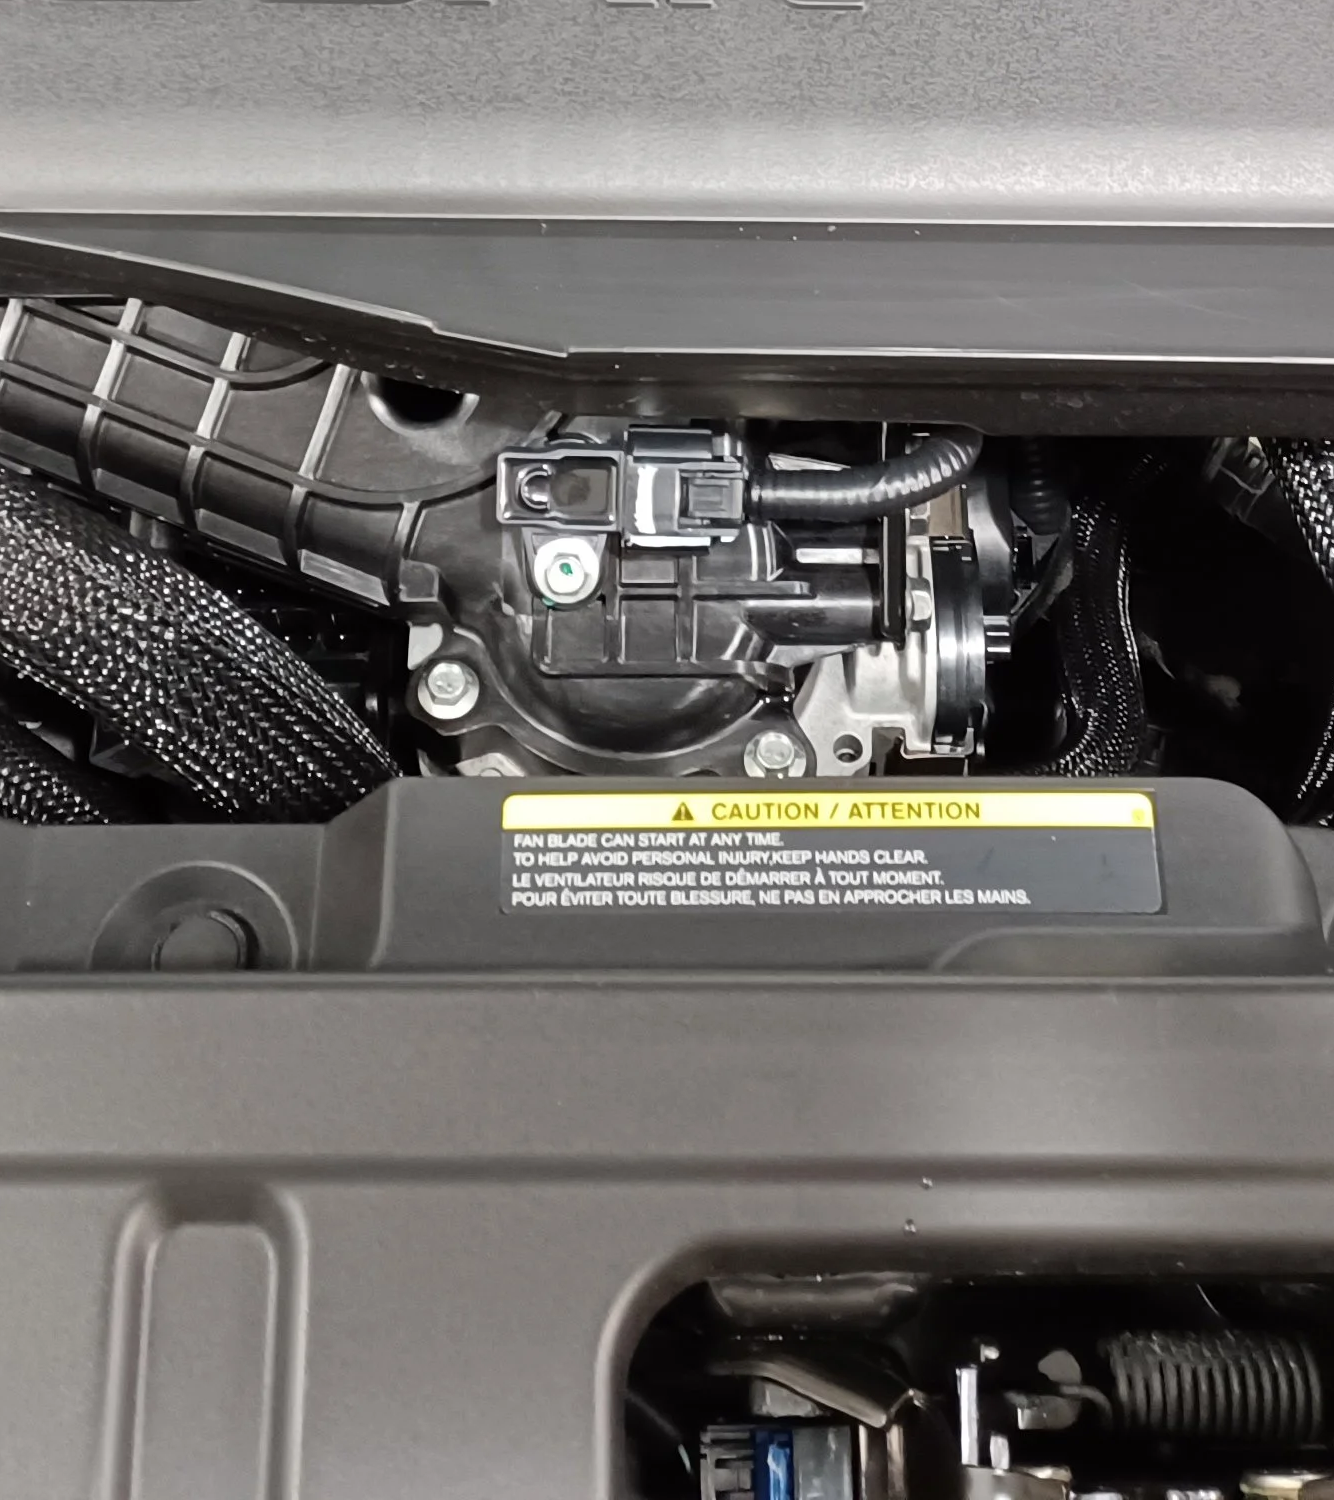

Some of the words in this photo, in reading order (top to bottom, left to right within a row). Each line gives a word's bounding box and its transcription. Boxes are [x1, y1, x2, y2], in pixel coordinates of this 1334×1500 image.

[711, 802, 819, 821] CAUTION
[829, 802, 839, 820] /
[848, 802, 981, 820] ATTENTION
[514, 833, 544, 848] FAN
[548, 833, 597, 848] BLADE
[601, 832, 635, 847] CAN
[637, 832, 685, 847] START
[688, 832, 707, 847] AT
[711, 832, 742, 847] ANY
[746, 832, 784, 846] TIME.
[513, 852, 533, 867] TO
[538, 851, 578, 866] HELP
[581, 851, 628, 866] AVOID
[632, 850, 715, 865] PERSONAL
[816, 850, 870, 864] HANDS
[874, 850, 928, 864] CLEAR.
[512, 873, 531, 887] LE
[534, 872, 635, 887] VENTILATEUR
[638, 871, 696, 886] RISQUE
[701, 871, 721, 886] DE
[725, 868, 811, 886] DÉMARRER
[814, 867, 826, 885] À
[829, 870, 869, 885] TOUT
[873, 870, 945, 885] MOMENT.
[511, 891, 557, 906] POUR
[561, 888, 612, 905] ÉVITER
[616, 890, 666, 905] TOUTE
[670, 890, 756, 906] BLESSURE,
[759, 890, 781, 904] NE
[784, 890, 815, 904] PAS
[818, 890, 840, 904] EN
[843, 889, 941, 904] APPROCHER
[945, 890, 974, 904] LES
[978, 890, 1032, 905] MAINS.
